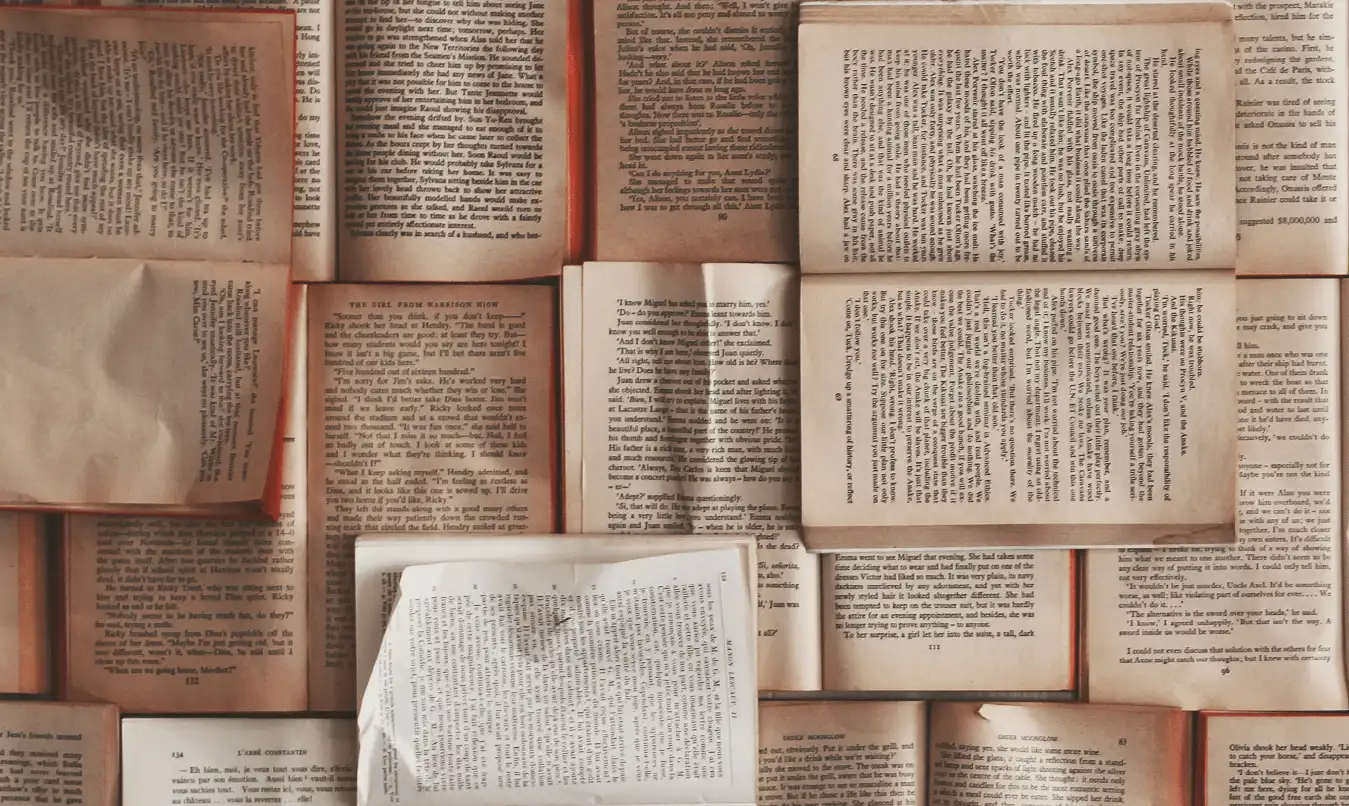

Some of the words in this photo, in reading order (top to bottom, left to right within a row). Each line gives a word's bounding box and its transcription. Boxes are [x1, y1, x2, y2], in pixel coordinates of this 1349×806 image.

[1153, 57, 1161, 68] He
[1153, 69, 1161, 90] stared
[1153, 91, 1161, 99] at
[1153, 100, 1161, 112] the
[1153, 112, 1161, 141] deserted
[833, 152, 839, 163] 68
[1151, 142, 1161, 172] clearing,
[1153, 173, 1161, 187] and
[1153, 187, 1161, 197] he
[717, 212, 728, 220] 90
[1153, 198, 1161, 244] remembered.
[1239, 216, 1274, 227] suggested
[1277, 216, 1320, 227] $8,000,000
[1323, 214, 1338, 224] and
[423, 229, 446, 237] search
[447, 229, 455, 238] of
[462, 229, 494, 240] husband,
[495, 230, 509, 238] and
[511, 230, 528, 239] who
[227, 318, 235, 334] into
[608, 327, 627, 335] know
[628, 329, 641, 337] you
[642, 327, 657, 335] well
[227, 334, 235, 347] the
[721, 348, 738, 356] Juan
[739, 348, 765, 358] quietly.
[355, 367, 386, 375] hundred
[387, 367, 400, 375] out
[401, 367, 410, 375] of
[411, 367, 438, 375] sixteen
[713, 377, 735, 387] pocket
[737, 377, 750, 385] and
[751, 377, 772, 385] asked
[836, 392, 842, 402] 69
[835, 552, 857, 560] Emma
[859, 552, 875, 560] went
[876, 552, 884, 560] to
[897, 552, 922, 562] Miguel
[923, 552, 937, 560] that
[938, 553, 968, 562] evening.
[968, 552, 981, 560] She
[982, 552, 995, 560] had
[996, 552, 1015, 560] taken
[1154, 655, 1175, 664] might
[1209, 655, 1243, 664] thoughts;
[185, 676, 200, 685] 132
[1229, 742, 1250, 751] Olivia
[1252, 742, 1273, 751] shook
[1275, 742, 1287, 751] her
[1289, 743, 1307, 751] head
[1309, 743, 1335, 753] weakly.
